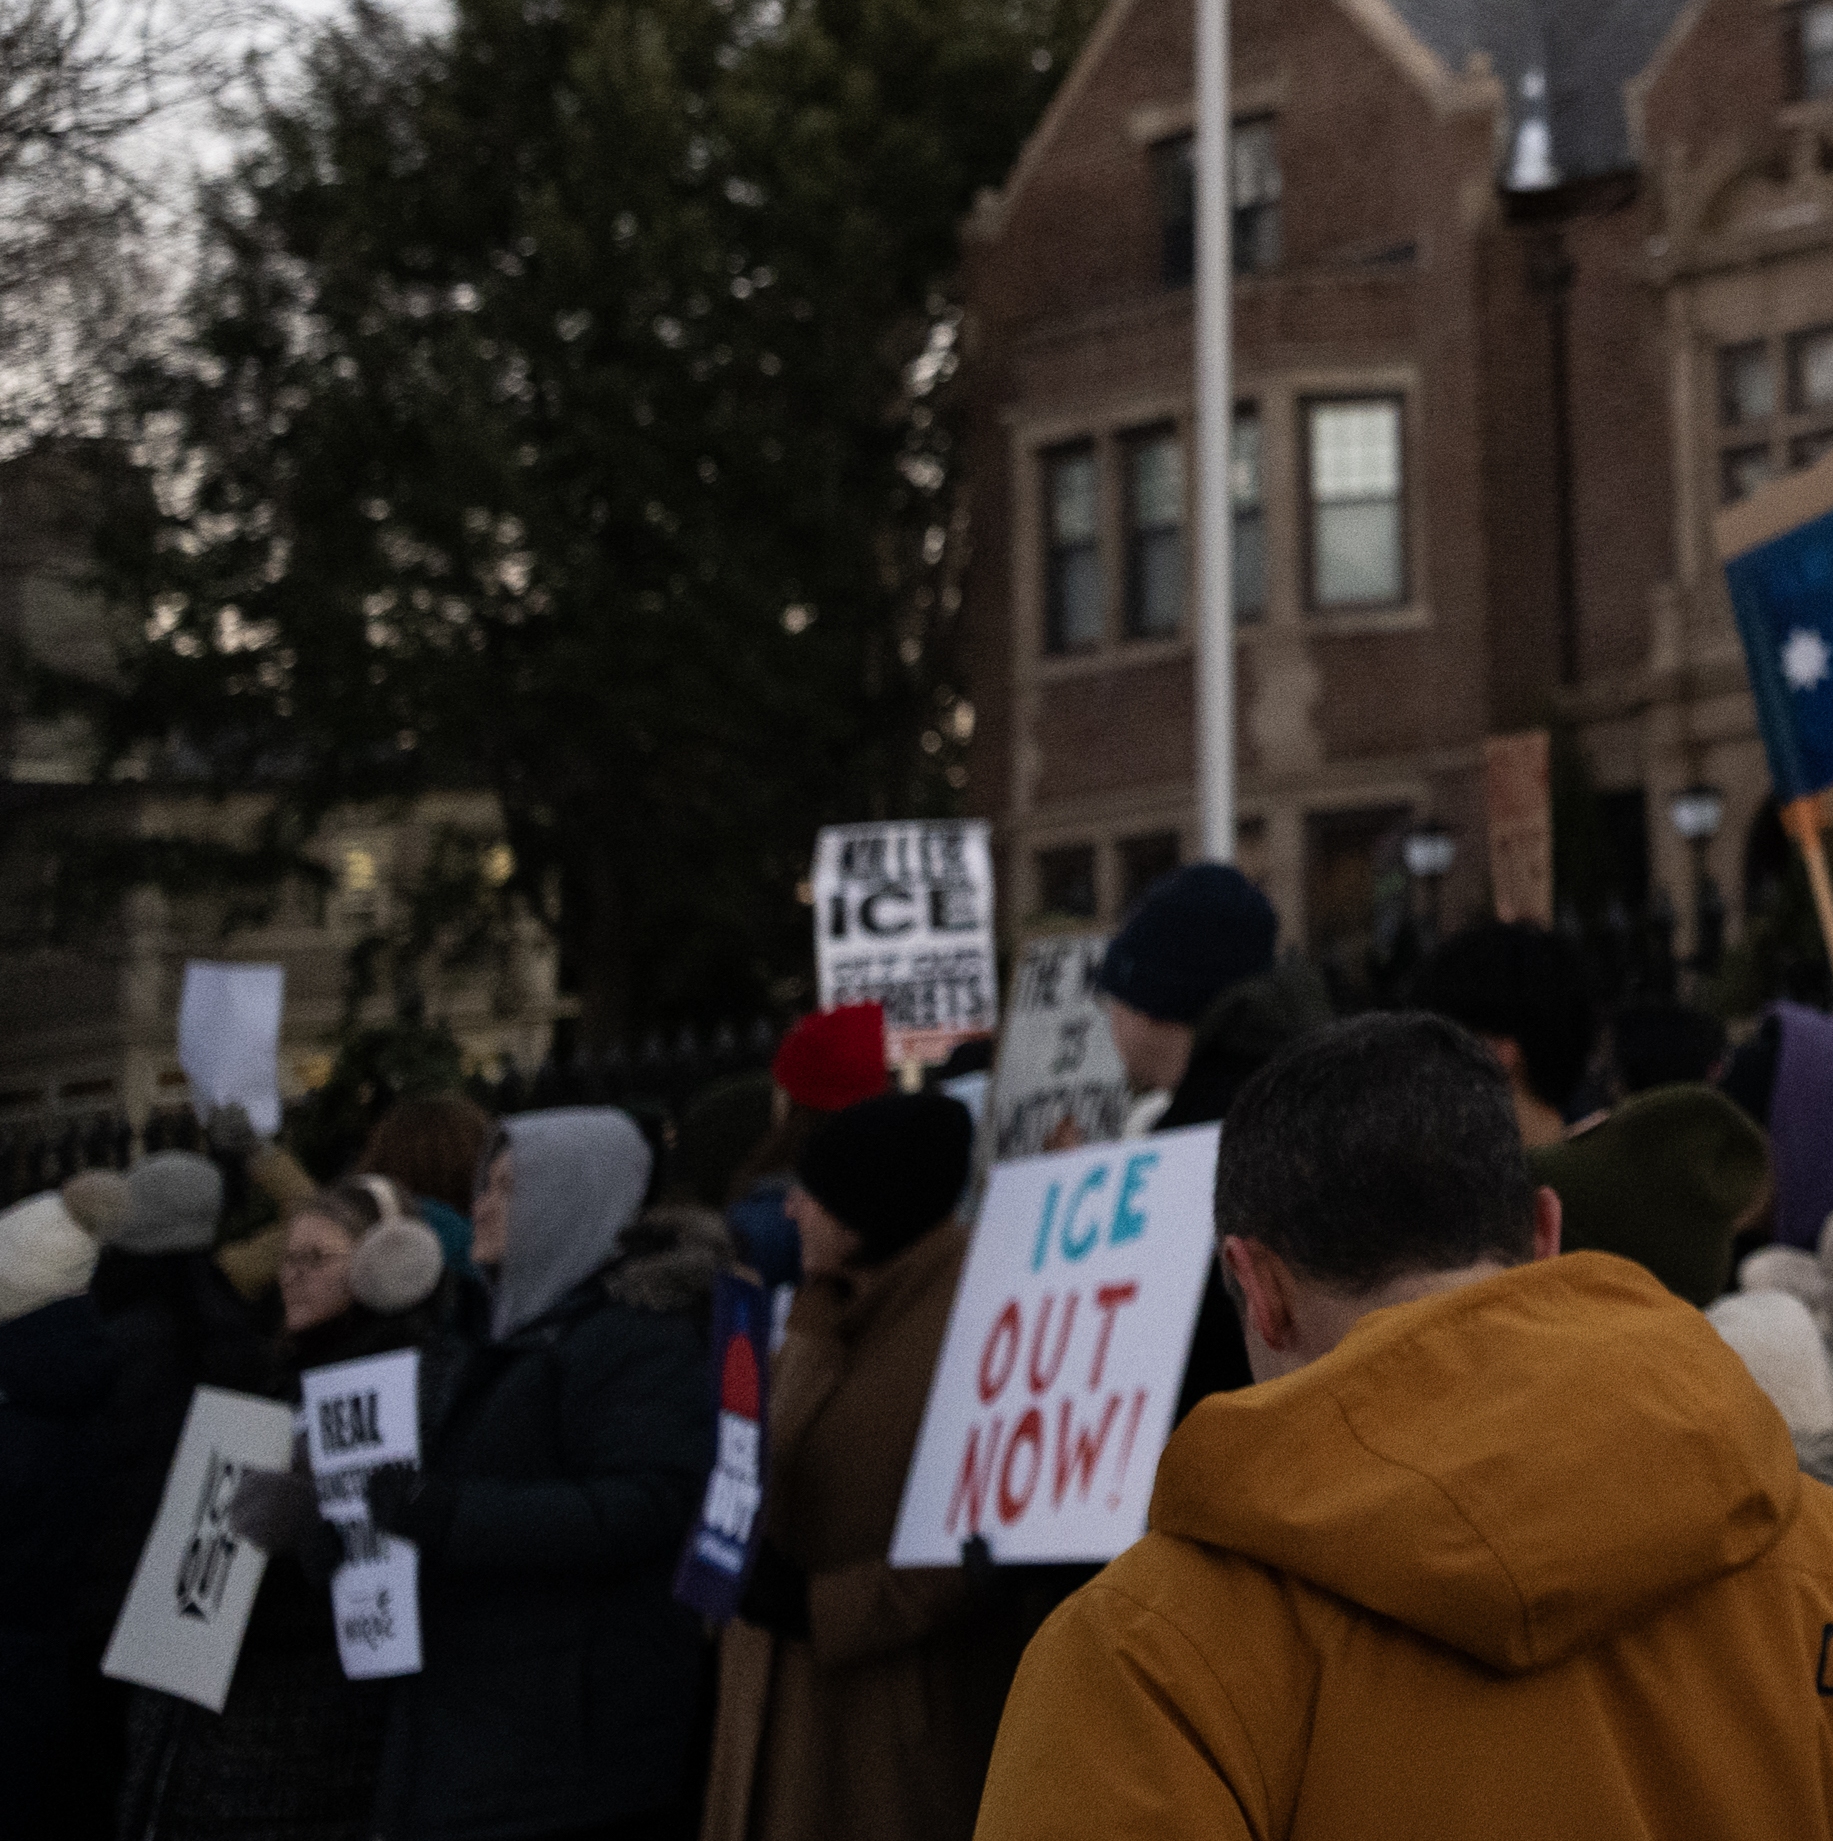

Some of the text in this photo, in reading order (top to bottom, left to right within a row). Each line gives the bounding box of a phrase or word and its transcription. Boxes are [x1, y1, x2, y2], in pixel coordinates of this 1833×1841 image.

[829, 885, 981, 939] ICE
[1031, 1152, 1161, 1275] ICE
[976, 1278, 1140, 1407] OUT
[943, 1386, 1149, 1536] NOW!
